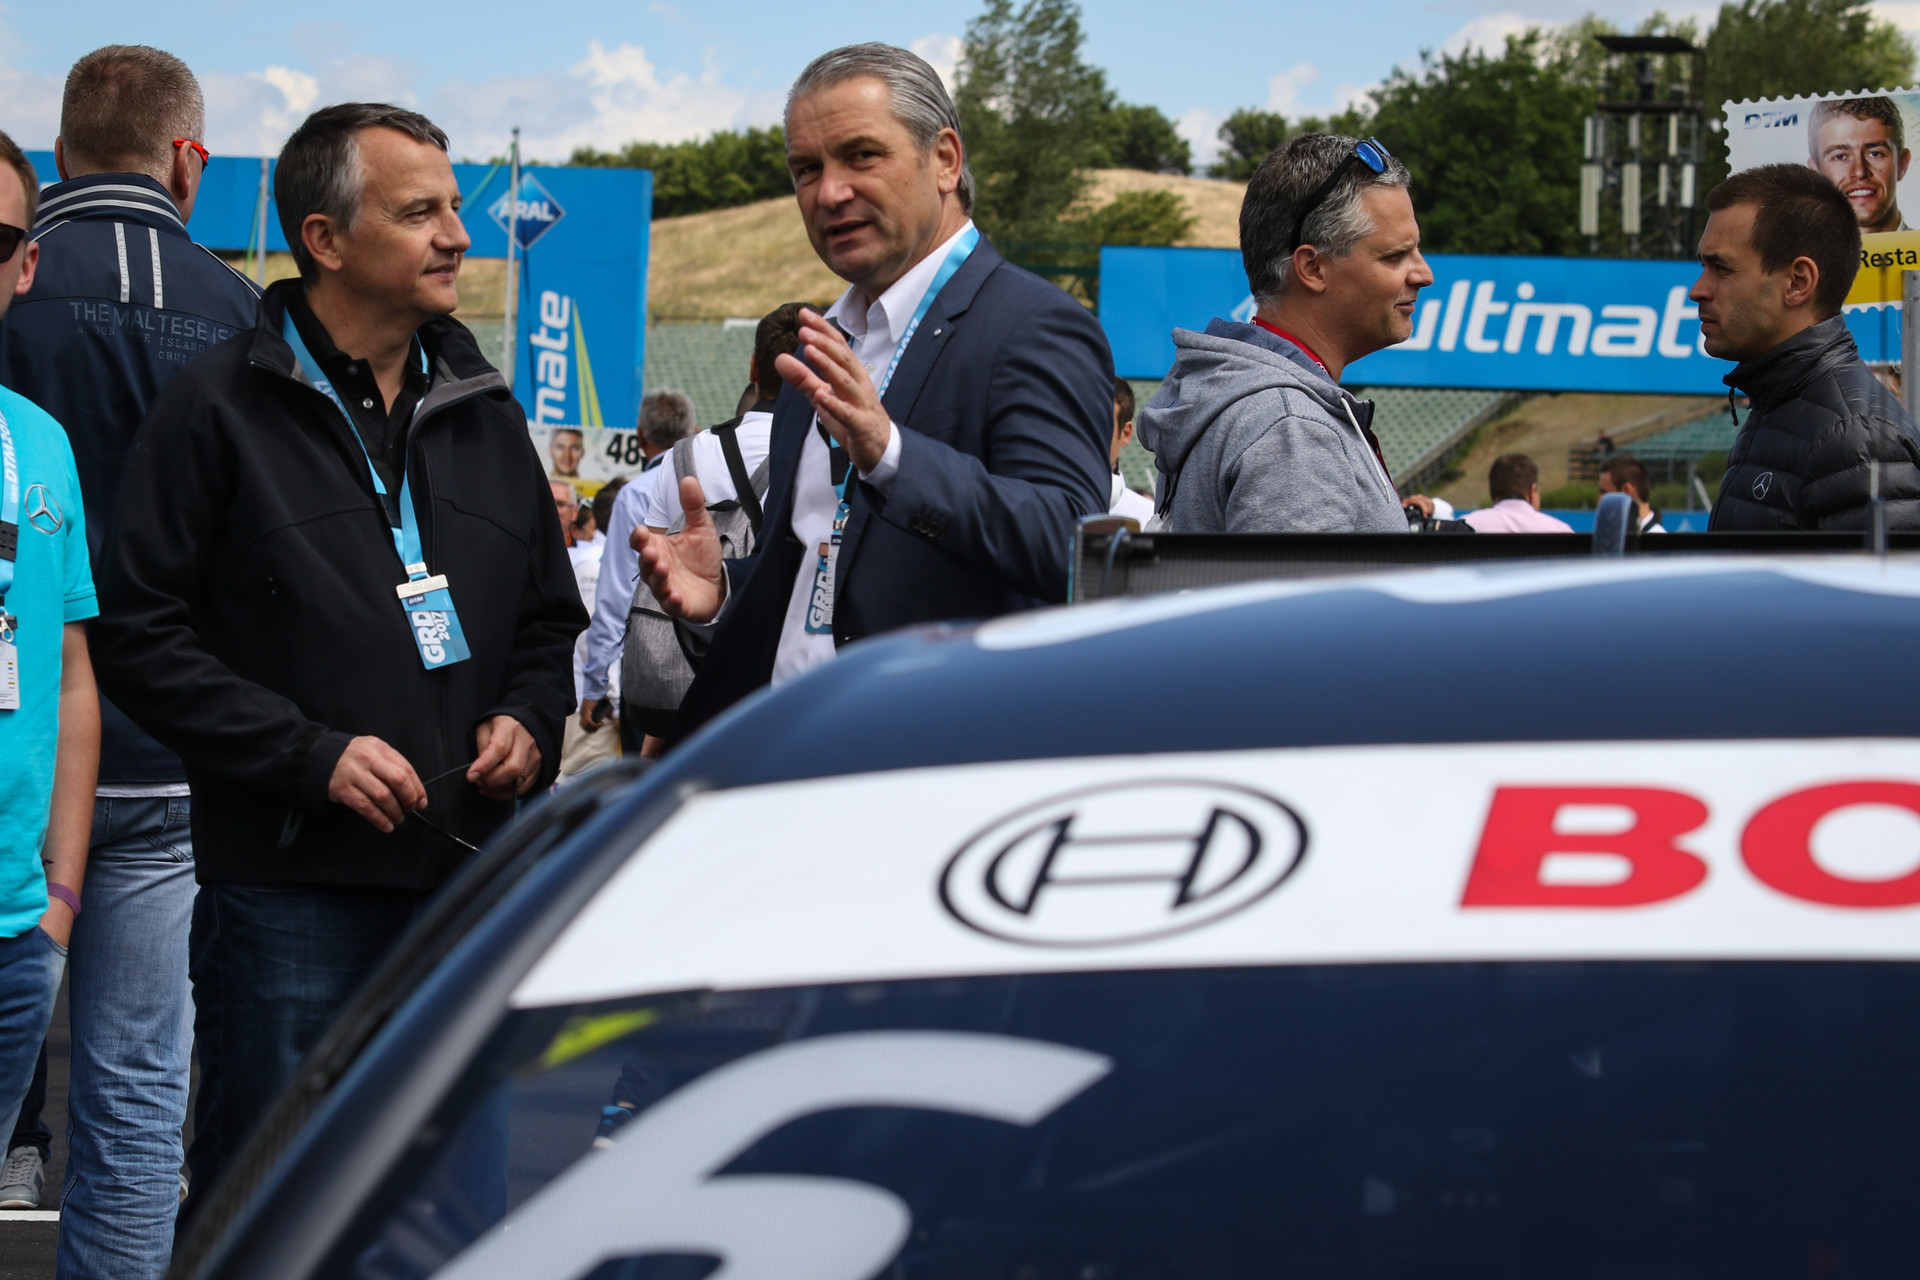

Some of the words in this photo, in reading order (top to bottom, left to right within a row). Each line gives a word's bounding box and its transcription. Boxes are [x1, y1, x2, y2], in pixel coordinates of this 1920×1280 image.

[1743, 110, 1799, 129] DTM
[499, 200, 555, 221] ARAL
[1861, 248, 1918, 268] Resta
[70, 302, 109, 323] THE
[113, 307, 208, 341] MALTESE
[1385, 279, 1714, 360] ultimat
[606, 433, 641, 466] 48
[1458, 780, 1920, 911] BO
